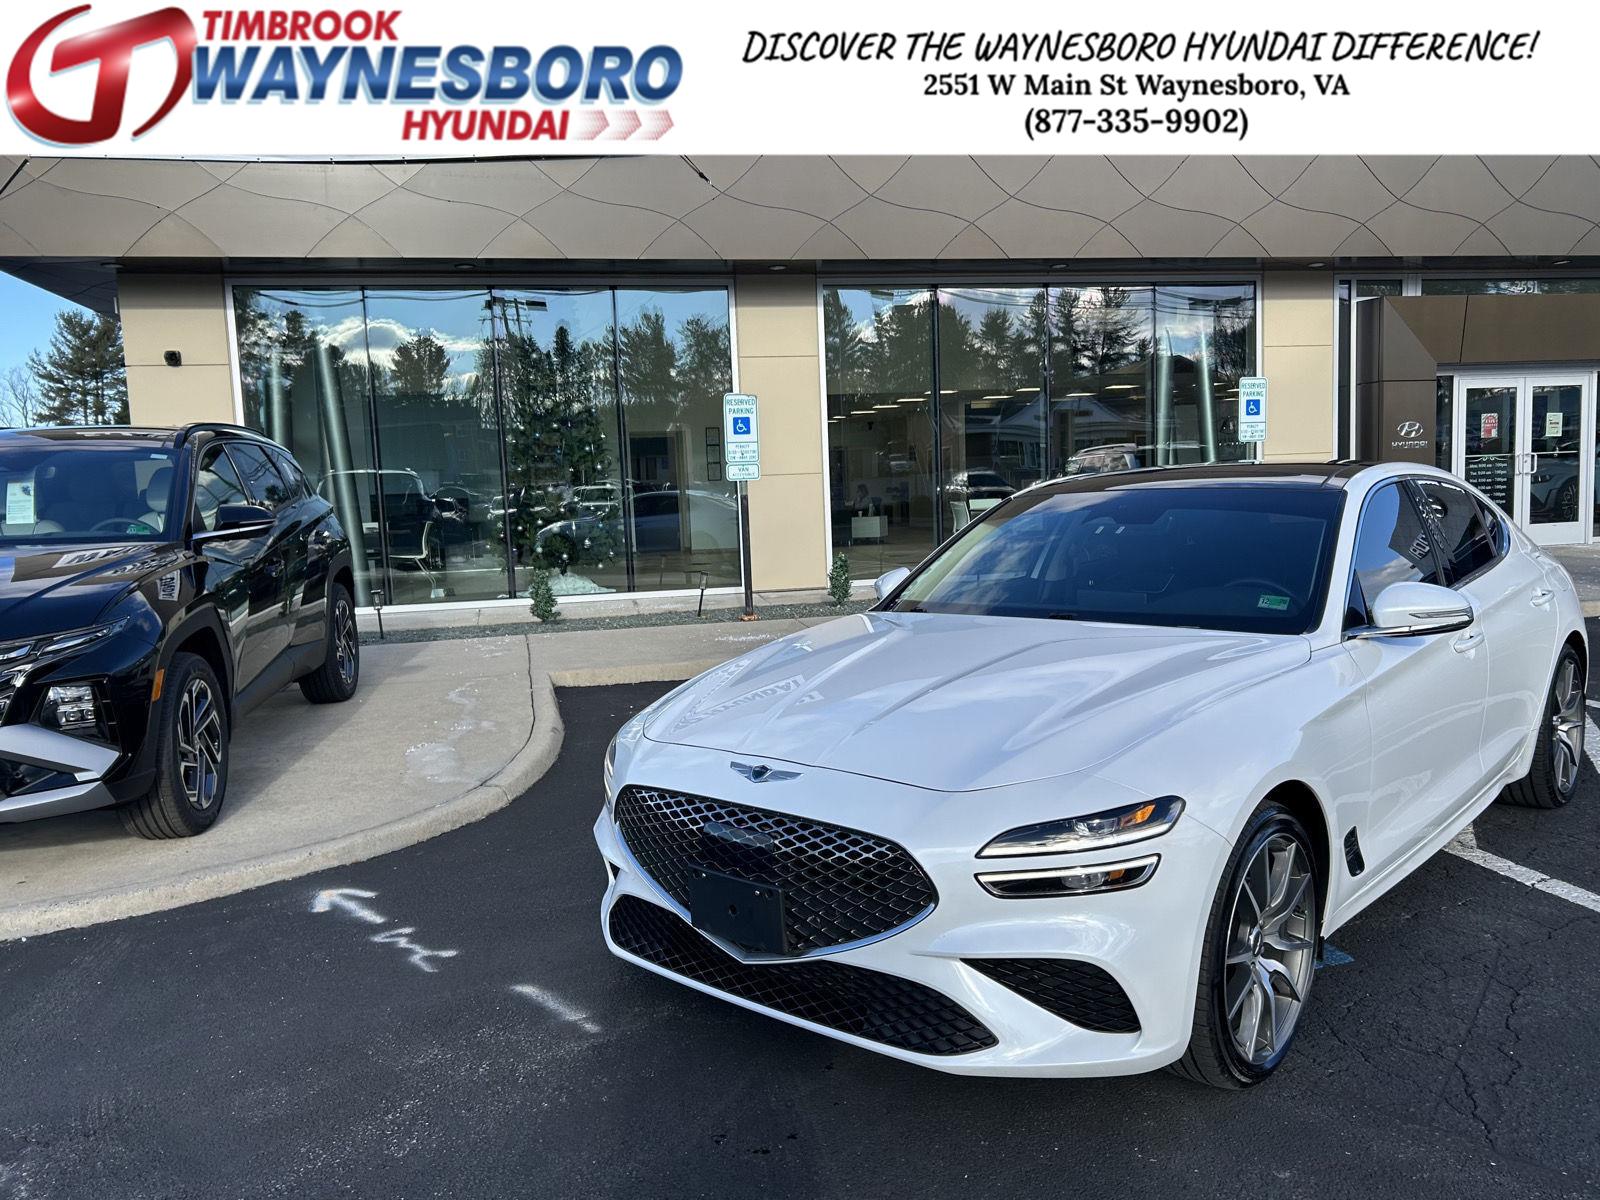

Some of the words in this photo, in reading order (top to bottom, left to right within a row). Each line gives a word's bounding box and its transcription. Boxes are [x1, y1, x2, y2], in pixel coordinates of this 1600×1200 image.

[1241, 382, 1266, 390] RESERVED
[1243, 390, 1264, 398] PARKING
[727, 398, 756, 406] RESERVED
[728, 407, 754, 415] PARKING
